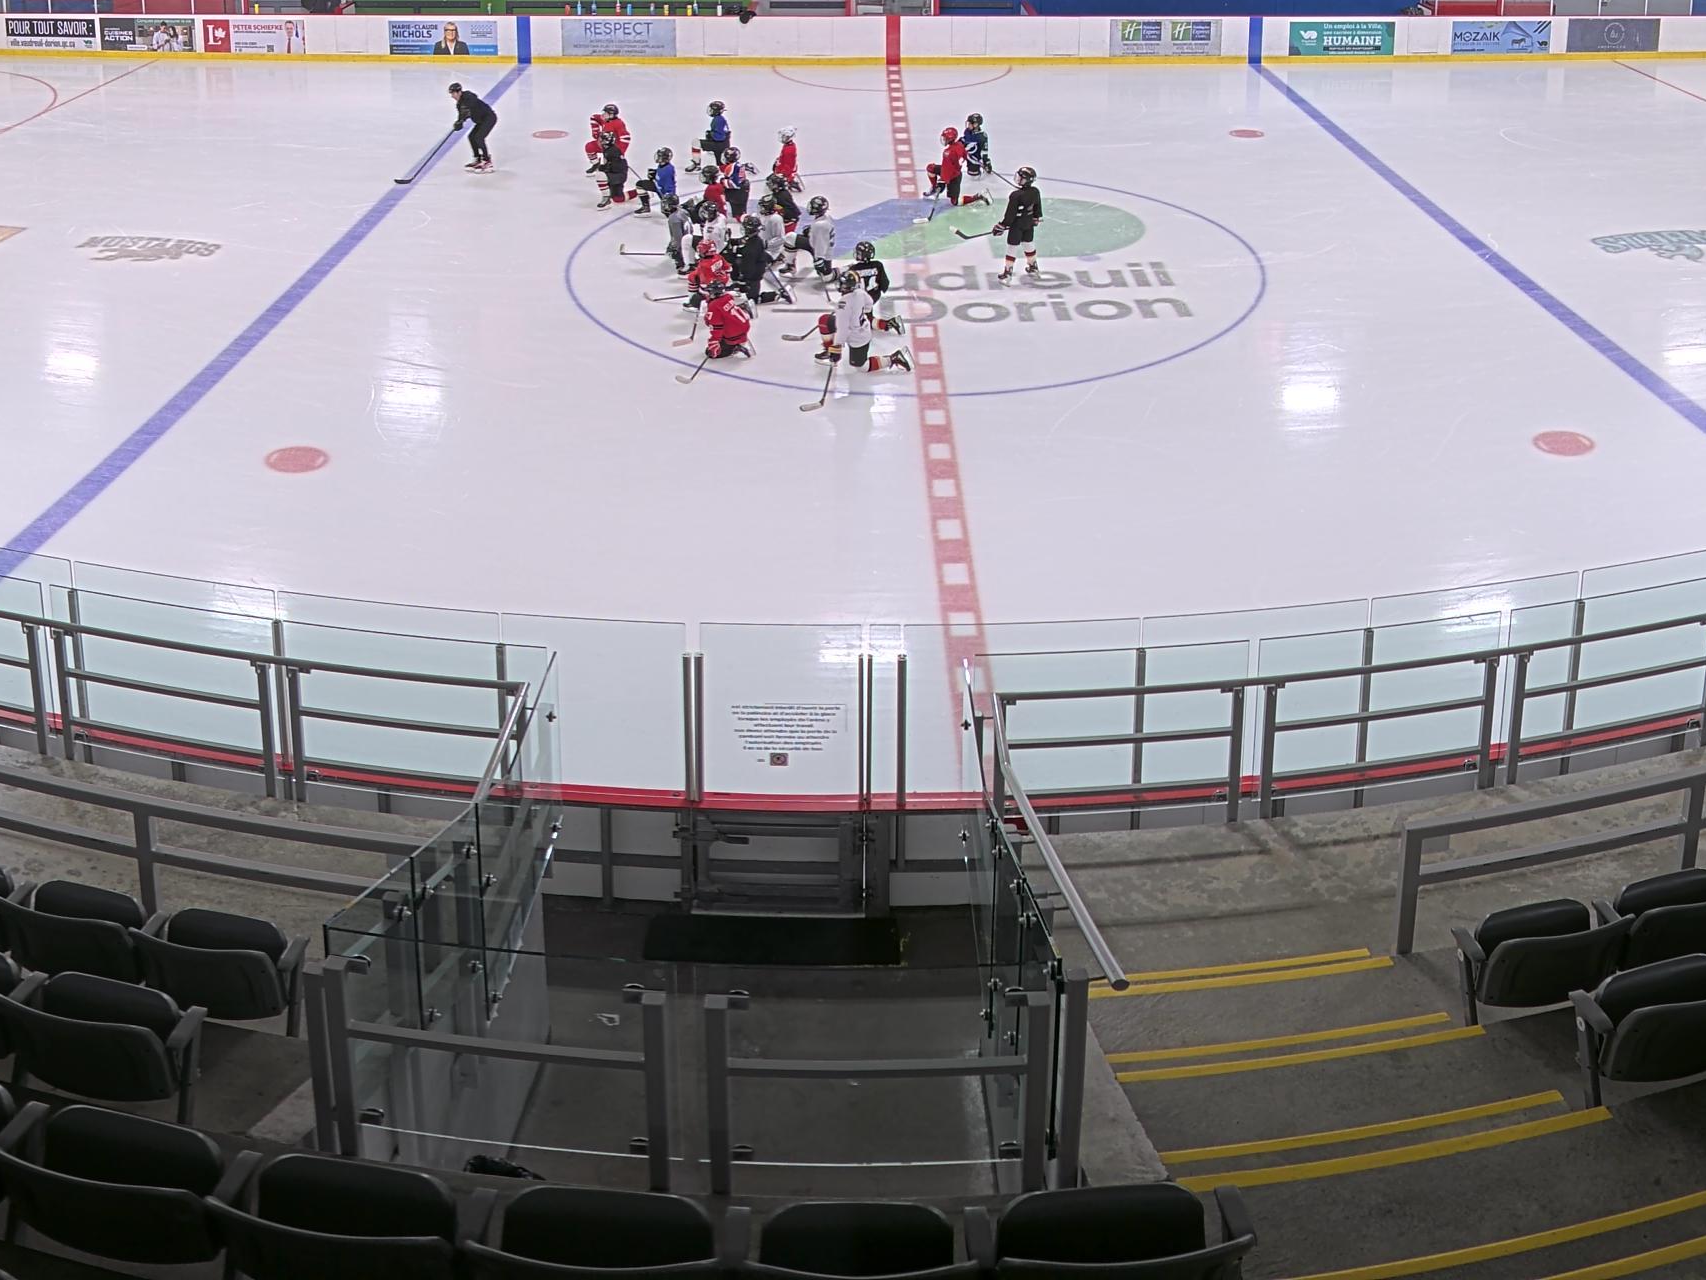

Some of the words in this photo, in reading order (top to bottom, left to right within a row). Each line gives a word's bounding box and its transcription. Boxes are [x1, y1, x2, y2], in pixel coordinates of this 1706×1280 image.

[8, 20, 31, 35] POUR
[31, 21, 54, 35] TOUT
[584, 22, 653, 36] RESPECT
[391, 30, 433, 39] NICHOLS
[1323, 35, 1382, 46] HUMAINE
[1453, 31, 1500, 42] MOZAIK
[75, 236, 221, 257] MUSTANGS
